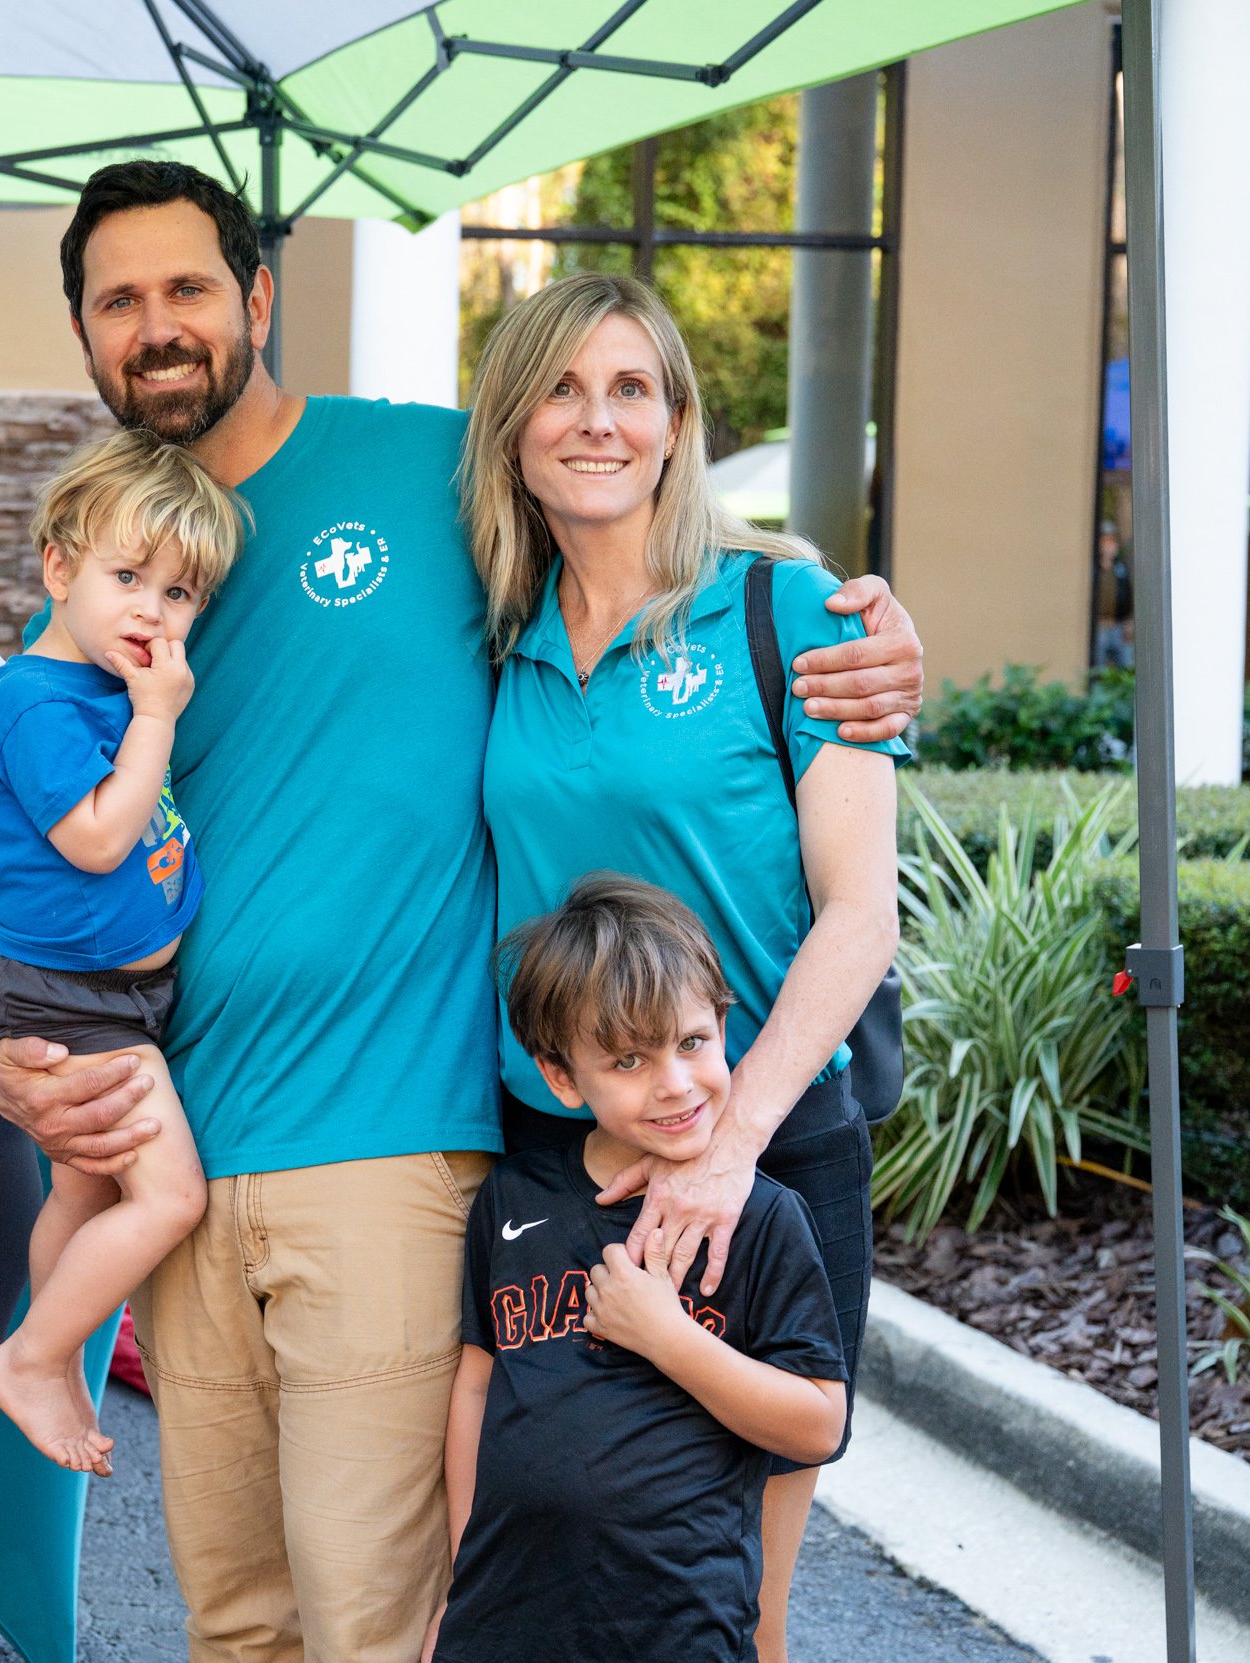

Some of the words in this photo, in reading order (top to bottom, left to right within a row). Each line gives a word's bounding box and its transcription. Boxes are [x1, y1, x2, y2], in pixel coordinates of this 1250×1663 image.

[312, 521, 366, 546] ECoVets
[376, 536, 389, 553] ER
[380, 555, 390, 563] &
[299, 562, 332, 608] Veterinary
[334, 566, 388, 608] Specialists
[665, 687, 720, 719] Specialists
[714, 662, 725, 676] ER
